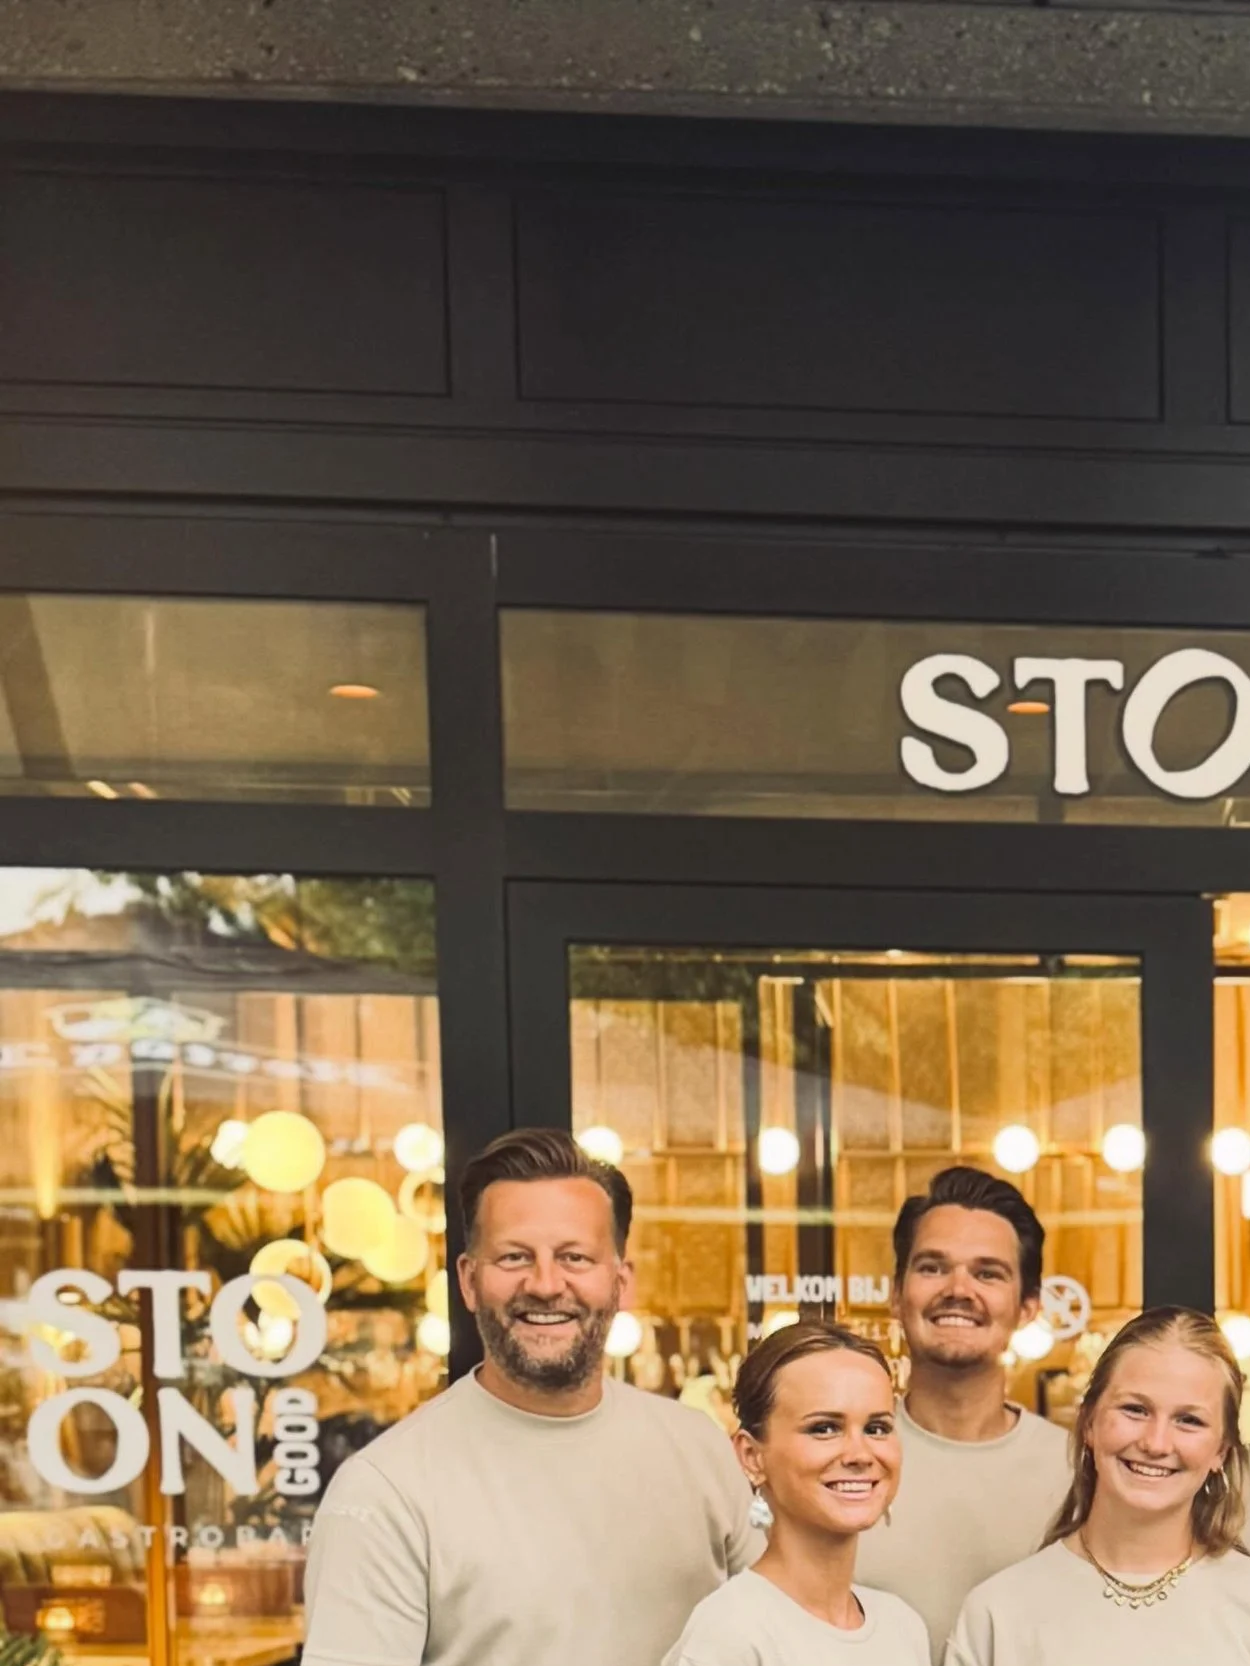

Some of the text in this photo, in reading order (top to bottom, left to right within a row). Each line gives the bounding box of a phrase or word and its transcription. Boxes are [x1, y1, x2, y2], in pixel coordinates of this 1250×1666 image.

[28, 1268, 327, 1378] STO
[745, 1275, 890, 1303] WELKOM BIJ
[27, 1387, 260, 1496] ON
[273, 1387, 321, 1496] GOOD
